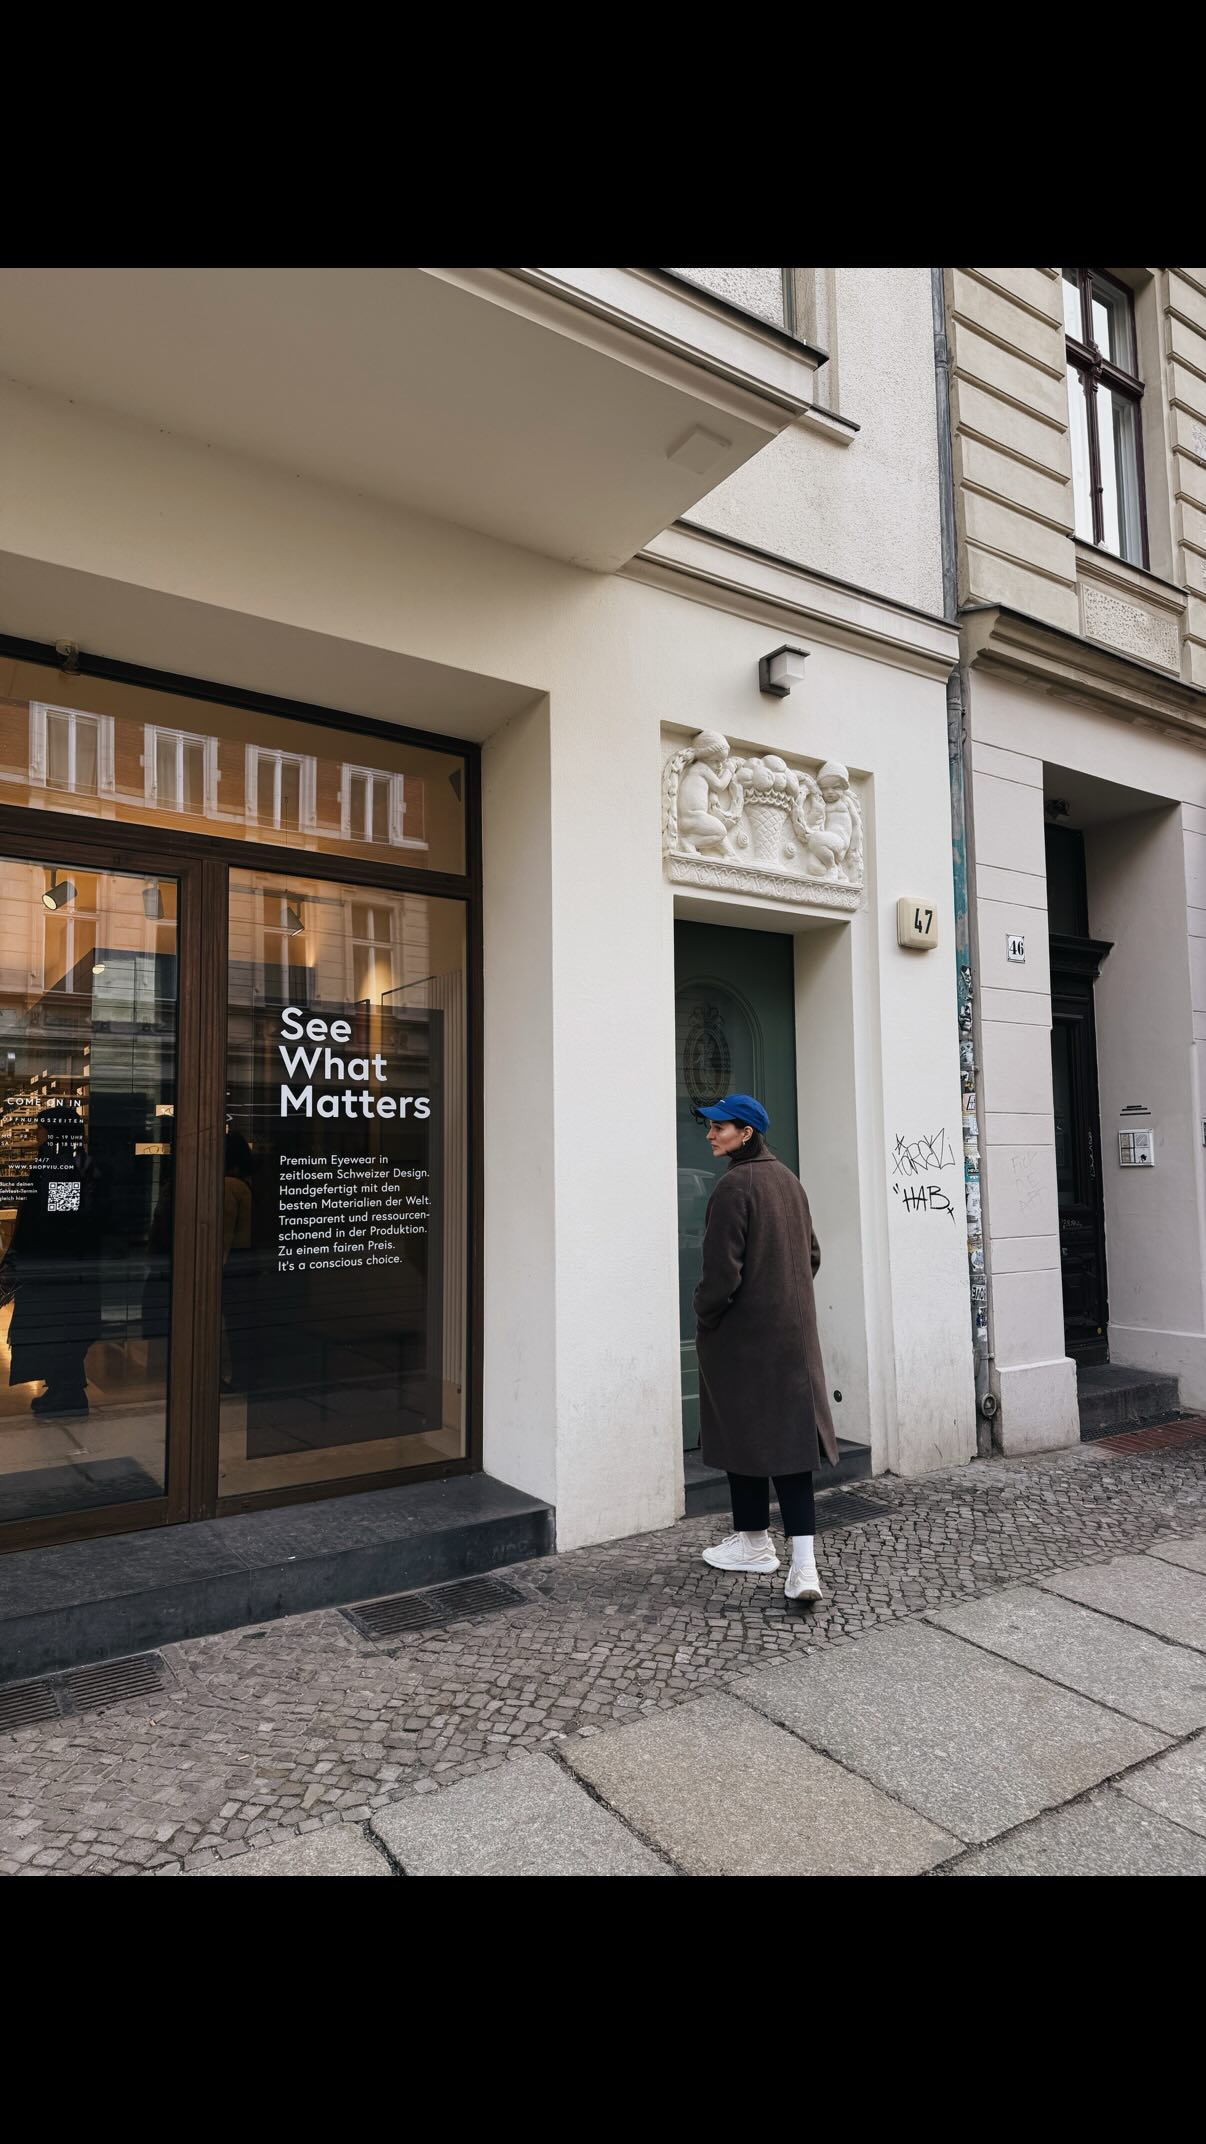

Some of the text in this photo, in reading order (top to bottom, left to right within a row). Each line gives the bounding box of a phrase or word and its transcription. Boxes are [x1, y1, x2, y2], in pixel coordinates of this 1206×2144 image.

[914, 908, 933, 934] 47
[1009, 940, 1024, 956] 46
[280, 1007, 352, 1043] See
[279, 1045, 388, 1082] What
[7, 1097, 41, 1106] COME
[69, 1099, 81, 1107] IN
[280, 1084, 432, 1119] Matters
[280, 1154, 389, 1168] Premium Eyewear in
[279, 1168, 430, 1180] zeitlosem Schweizer Design.
[279, 1183, 400, 1198] Handgefertigt mit den
[279, 1195, 432, 1211] besten Materialien der Welt.
[279, 1211, 430, 1227] Transparent und ressourcen-
[278, 1224, 428, 1241] schonend in der Produktion.
[278, 1240, 396, 1257] Zu einem fairen Preis.
[278, 1255, 403, 1272] It's a conscious choice.
